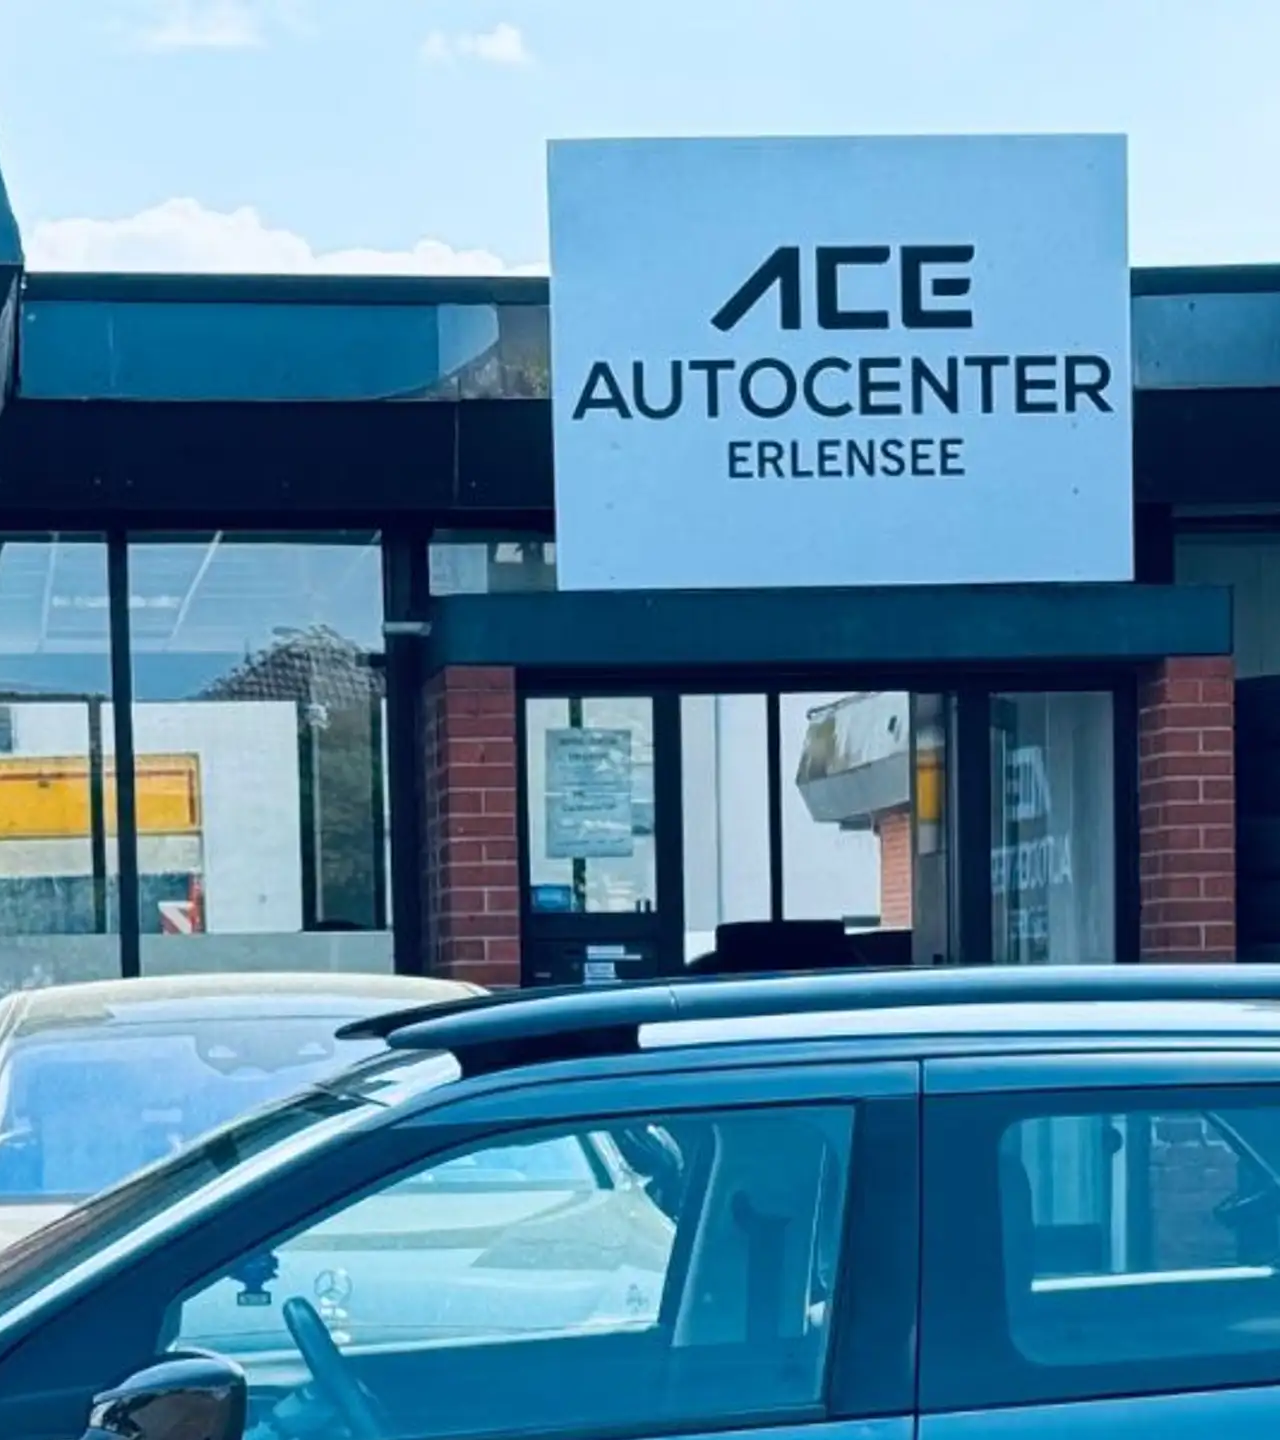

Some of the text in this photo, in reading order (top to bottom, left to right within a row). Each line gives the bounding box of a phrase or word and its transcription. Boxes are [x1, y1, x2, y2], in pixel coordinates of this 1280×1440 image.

[709, 245, 975, 332] ACE
[572, 354, 1115, 420] AUTOCENTER
[727, 438, 966, 479] ERLENSEE
